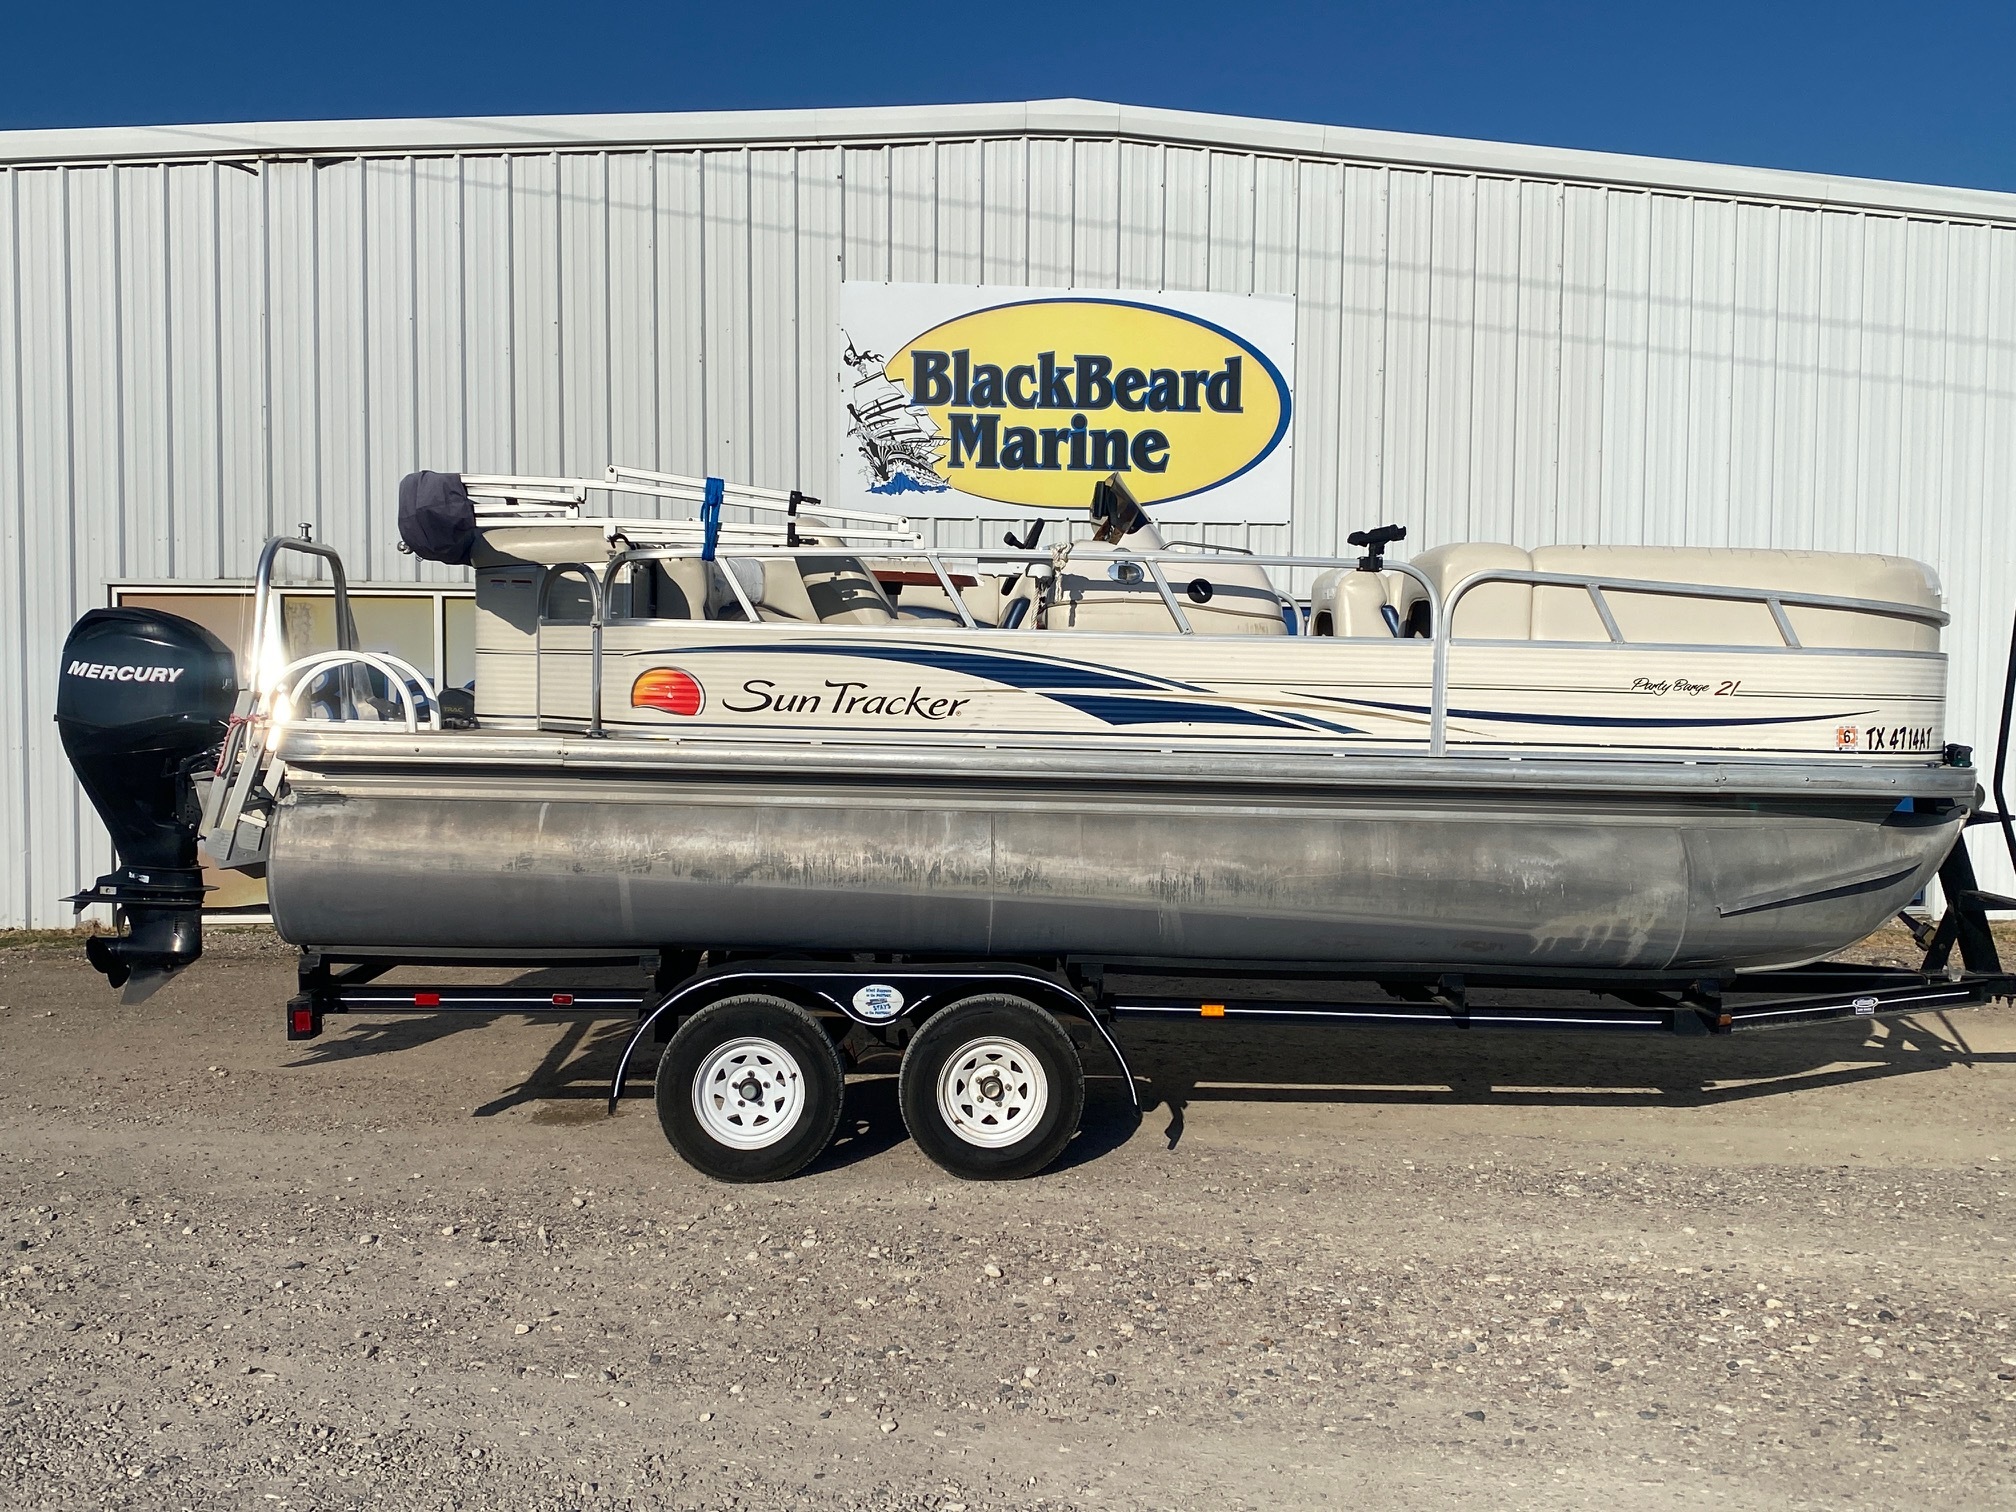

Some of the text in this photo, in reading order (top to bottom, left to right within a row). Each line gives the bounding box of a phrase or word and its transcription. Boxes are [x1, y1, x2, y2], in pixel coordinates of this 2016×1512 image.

[911, 349, 1244, 413] BlackBeard
[947, 412, 1170, 473] Marine
[67, 660, 184, 683] MERCURY
[722, 679, 971, 720] Sun Tracker
[1631, 677, 1742, 697] Party Barge 21
[1843, 729, 1851, 744] 6
[1866, 726, 1933, 751] TX 4714AT
